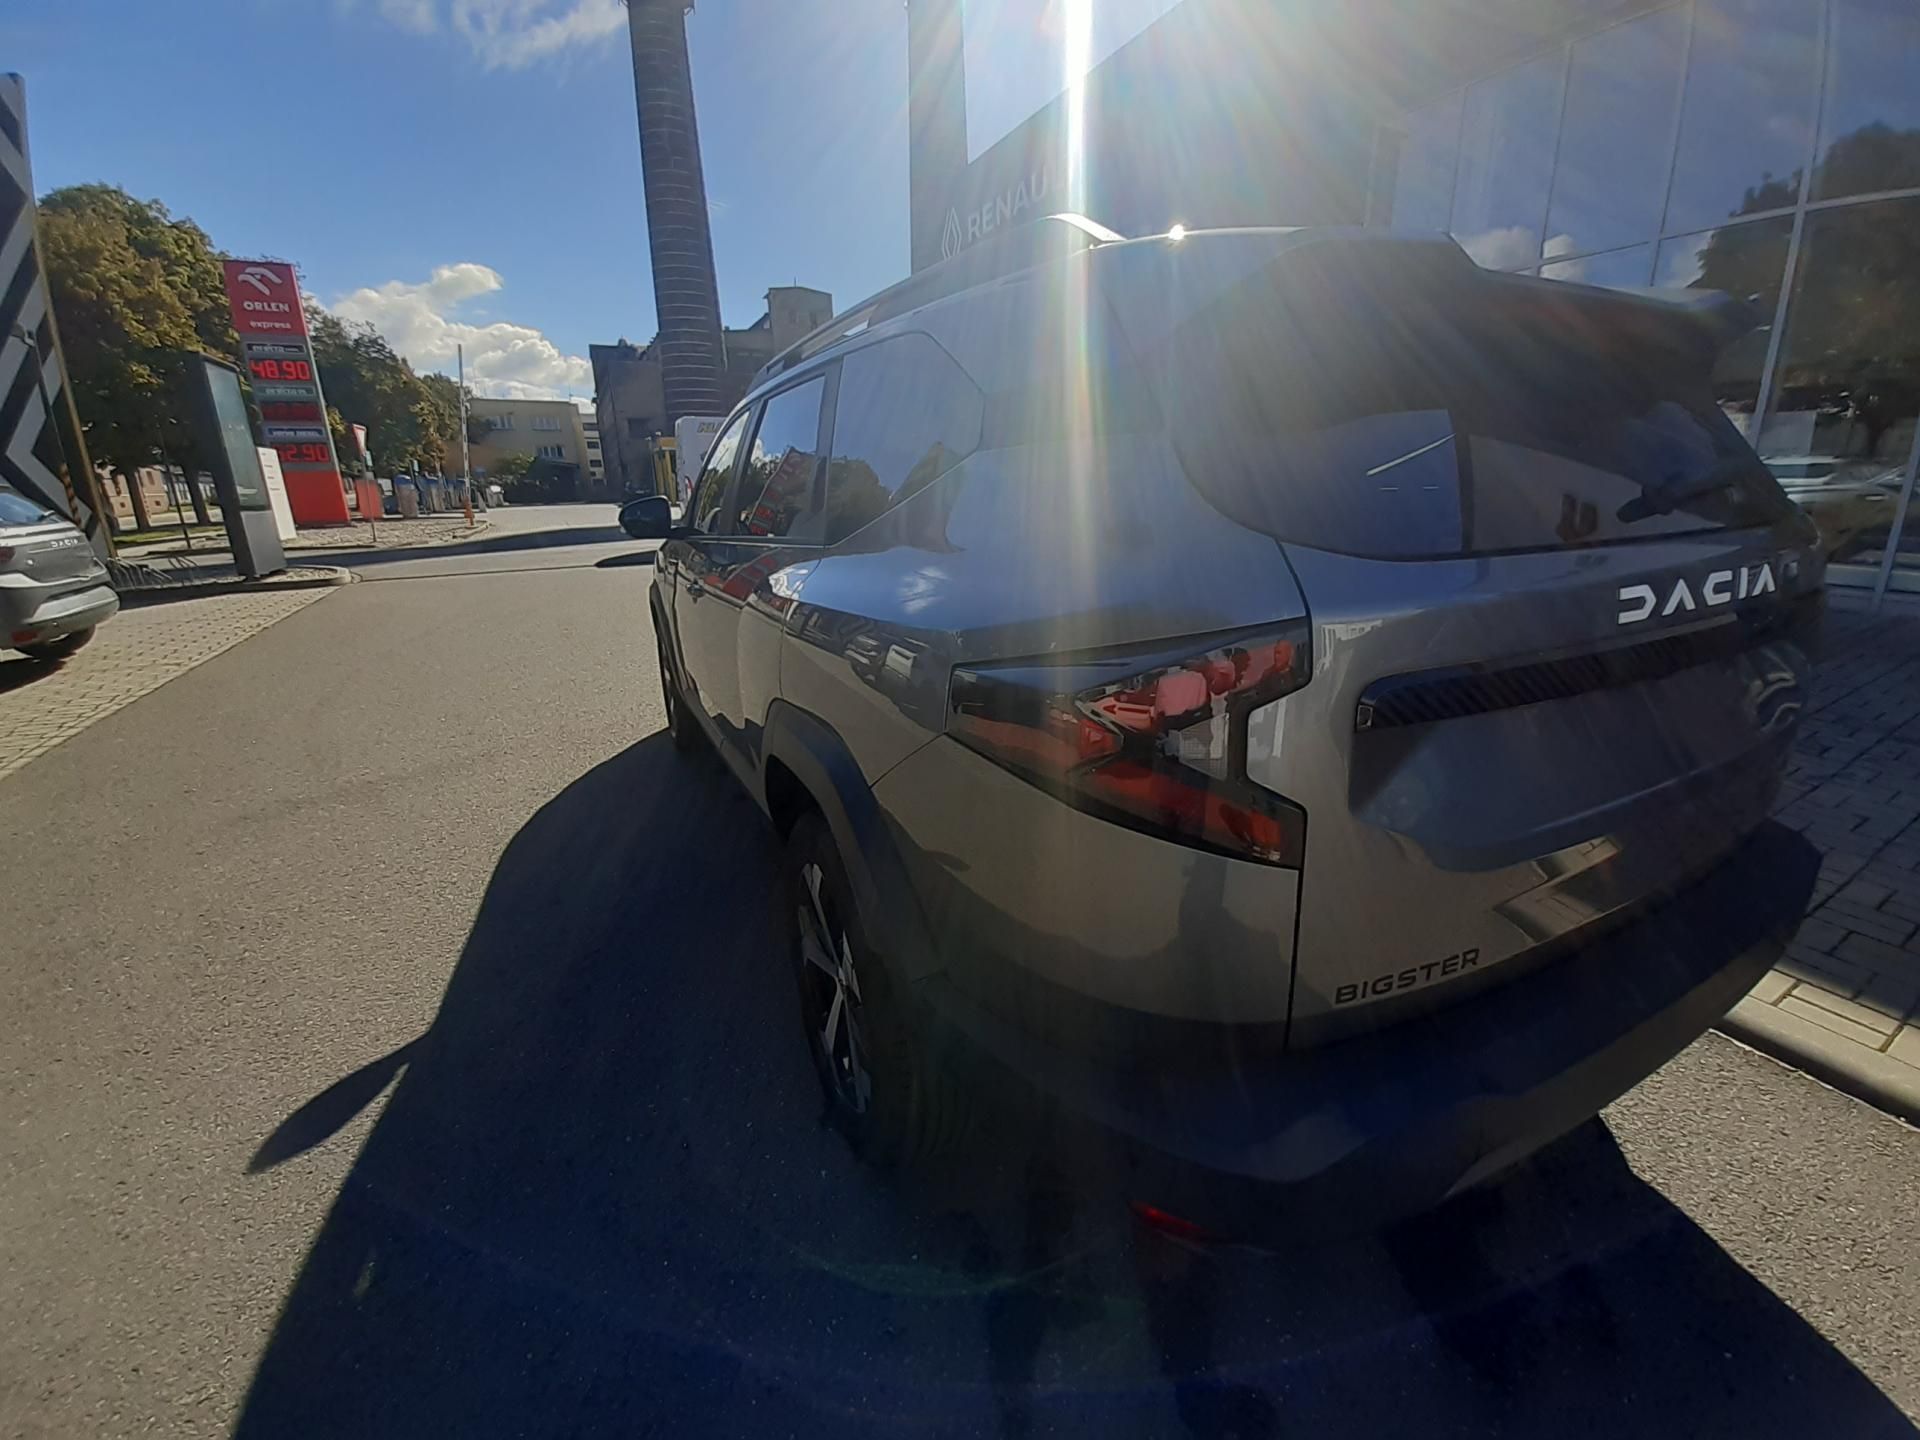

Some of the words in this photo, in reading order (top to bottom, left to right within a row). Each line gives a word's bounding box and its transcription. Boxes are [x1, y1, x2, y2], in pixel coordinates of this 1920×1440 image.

[967, 164, 1050, 243] RENAU
[243, 301, 290, 312] ORLEN
[250, 321, 292, 329] express
[250, 359, 311, 380] 48.90
[1617, 563, 1776, 625] DACIA
[1334, 948, 1480, 1005] BIGSTER
